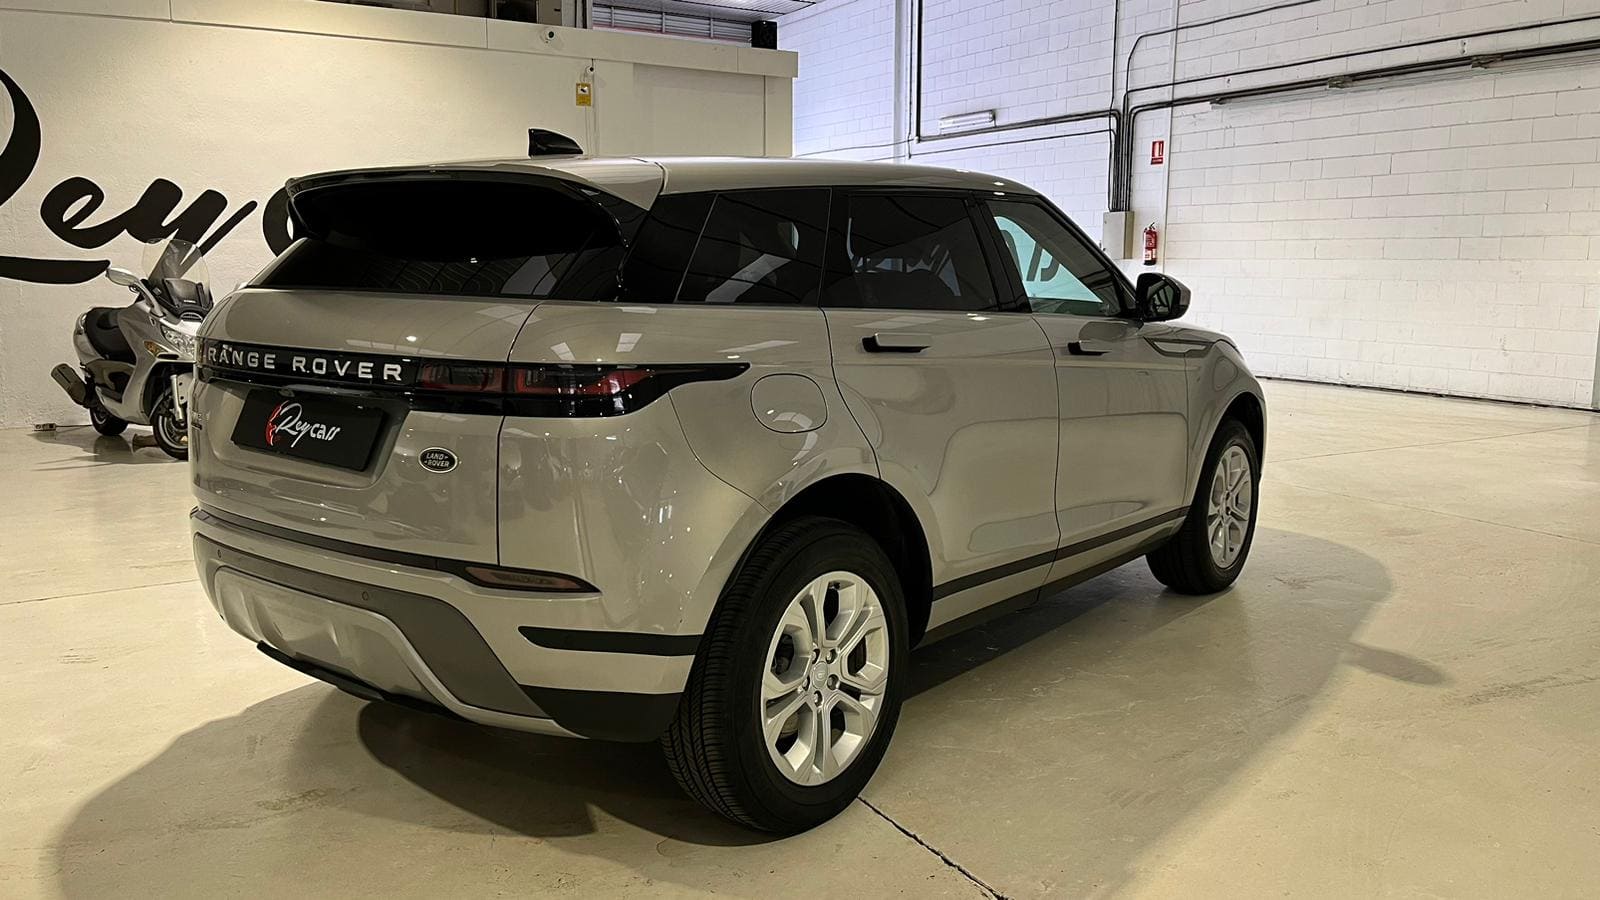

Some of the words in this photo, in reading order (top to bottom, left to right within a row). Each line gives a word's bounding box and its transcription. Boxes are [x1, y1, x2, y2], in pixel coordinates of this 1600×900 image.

[207, 346, 276, 370] RANGE
[292, 355, 402, 382] ROVER
[426, 452, 444, 461] LAND
[427, 459, 450, 468] ROVER
